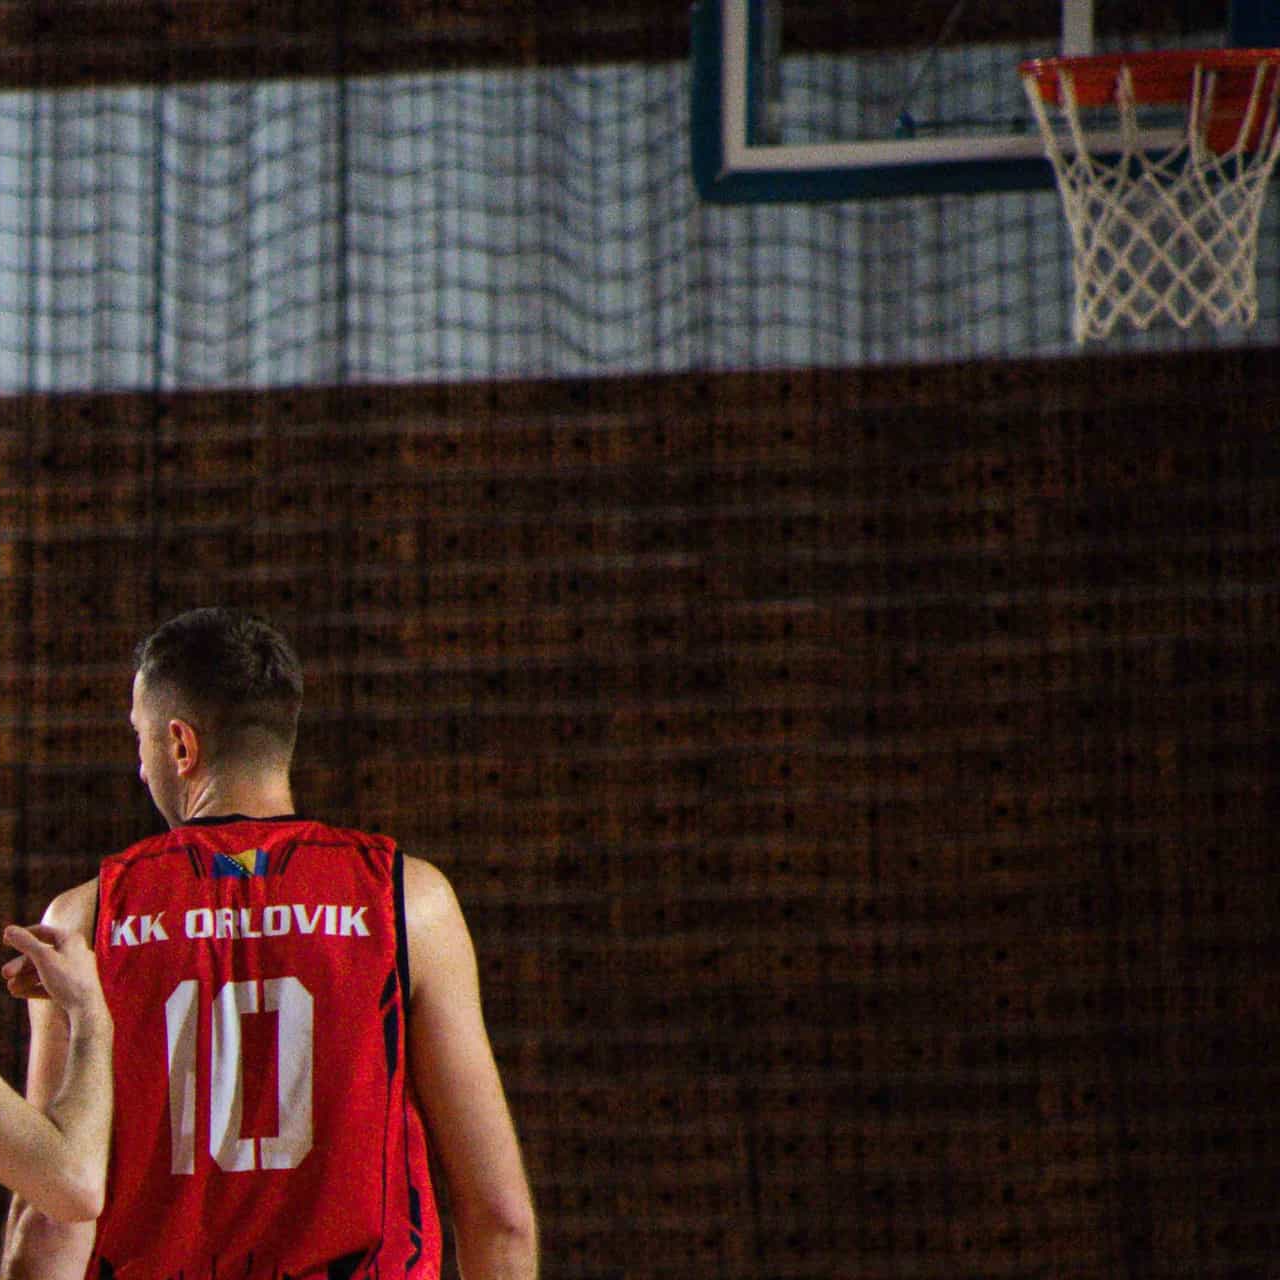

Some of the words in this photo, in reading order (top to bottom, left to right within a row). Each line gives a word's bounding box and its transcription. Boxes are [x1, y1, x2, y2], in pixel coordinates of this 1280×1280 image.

[111, 911, 169, 947] KK
[184, 904, 371, 939] ORLOVIK
[165, 976, 314, 1175] 10
